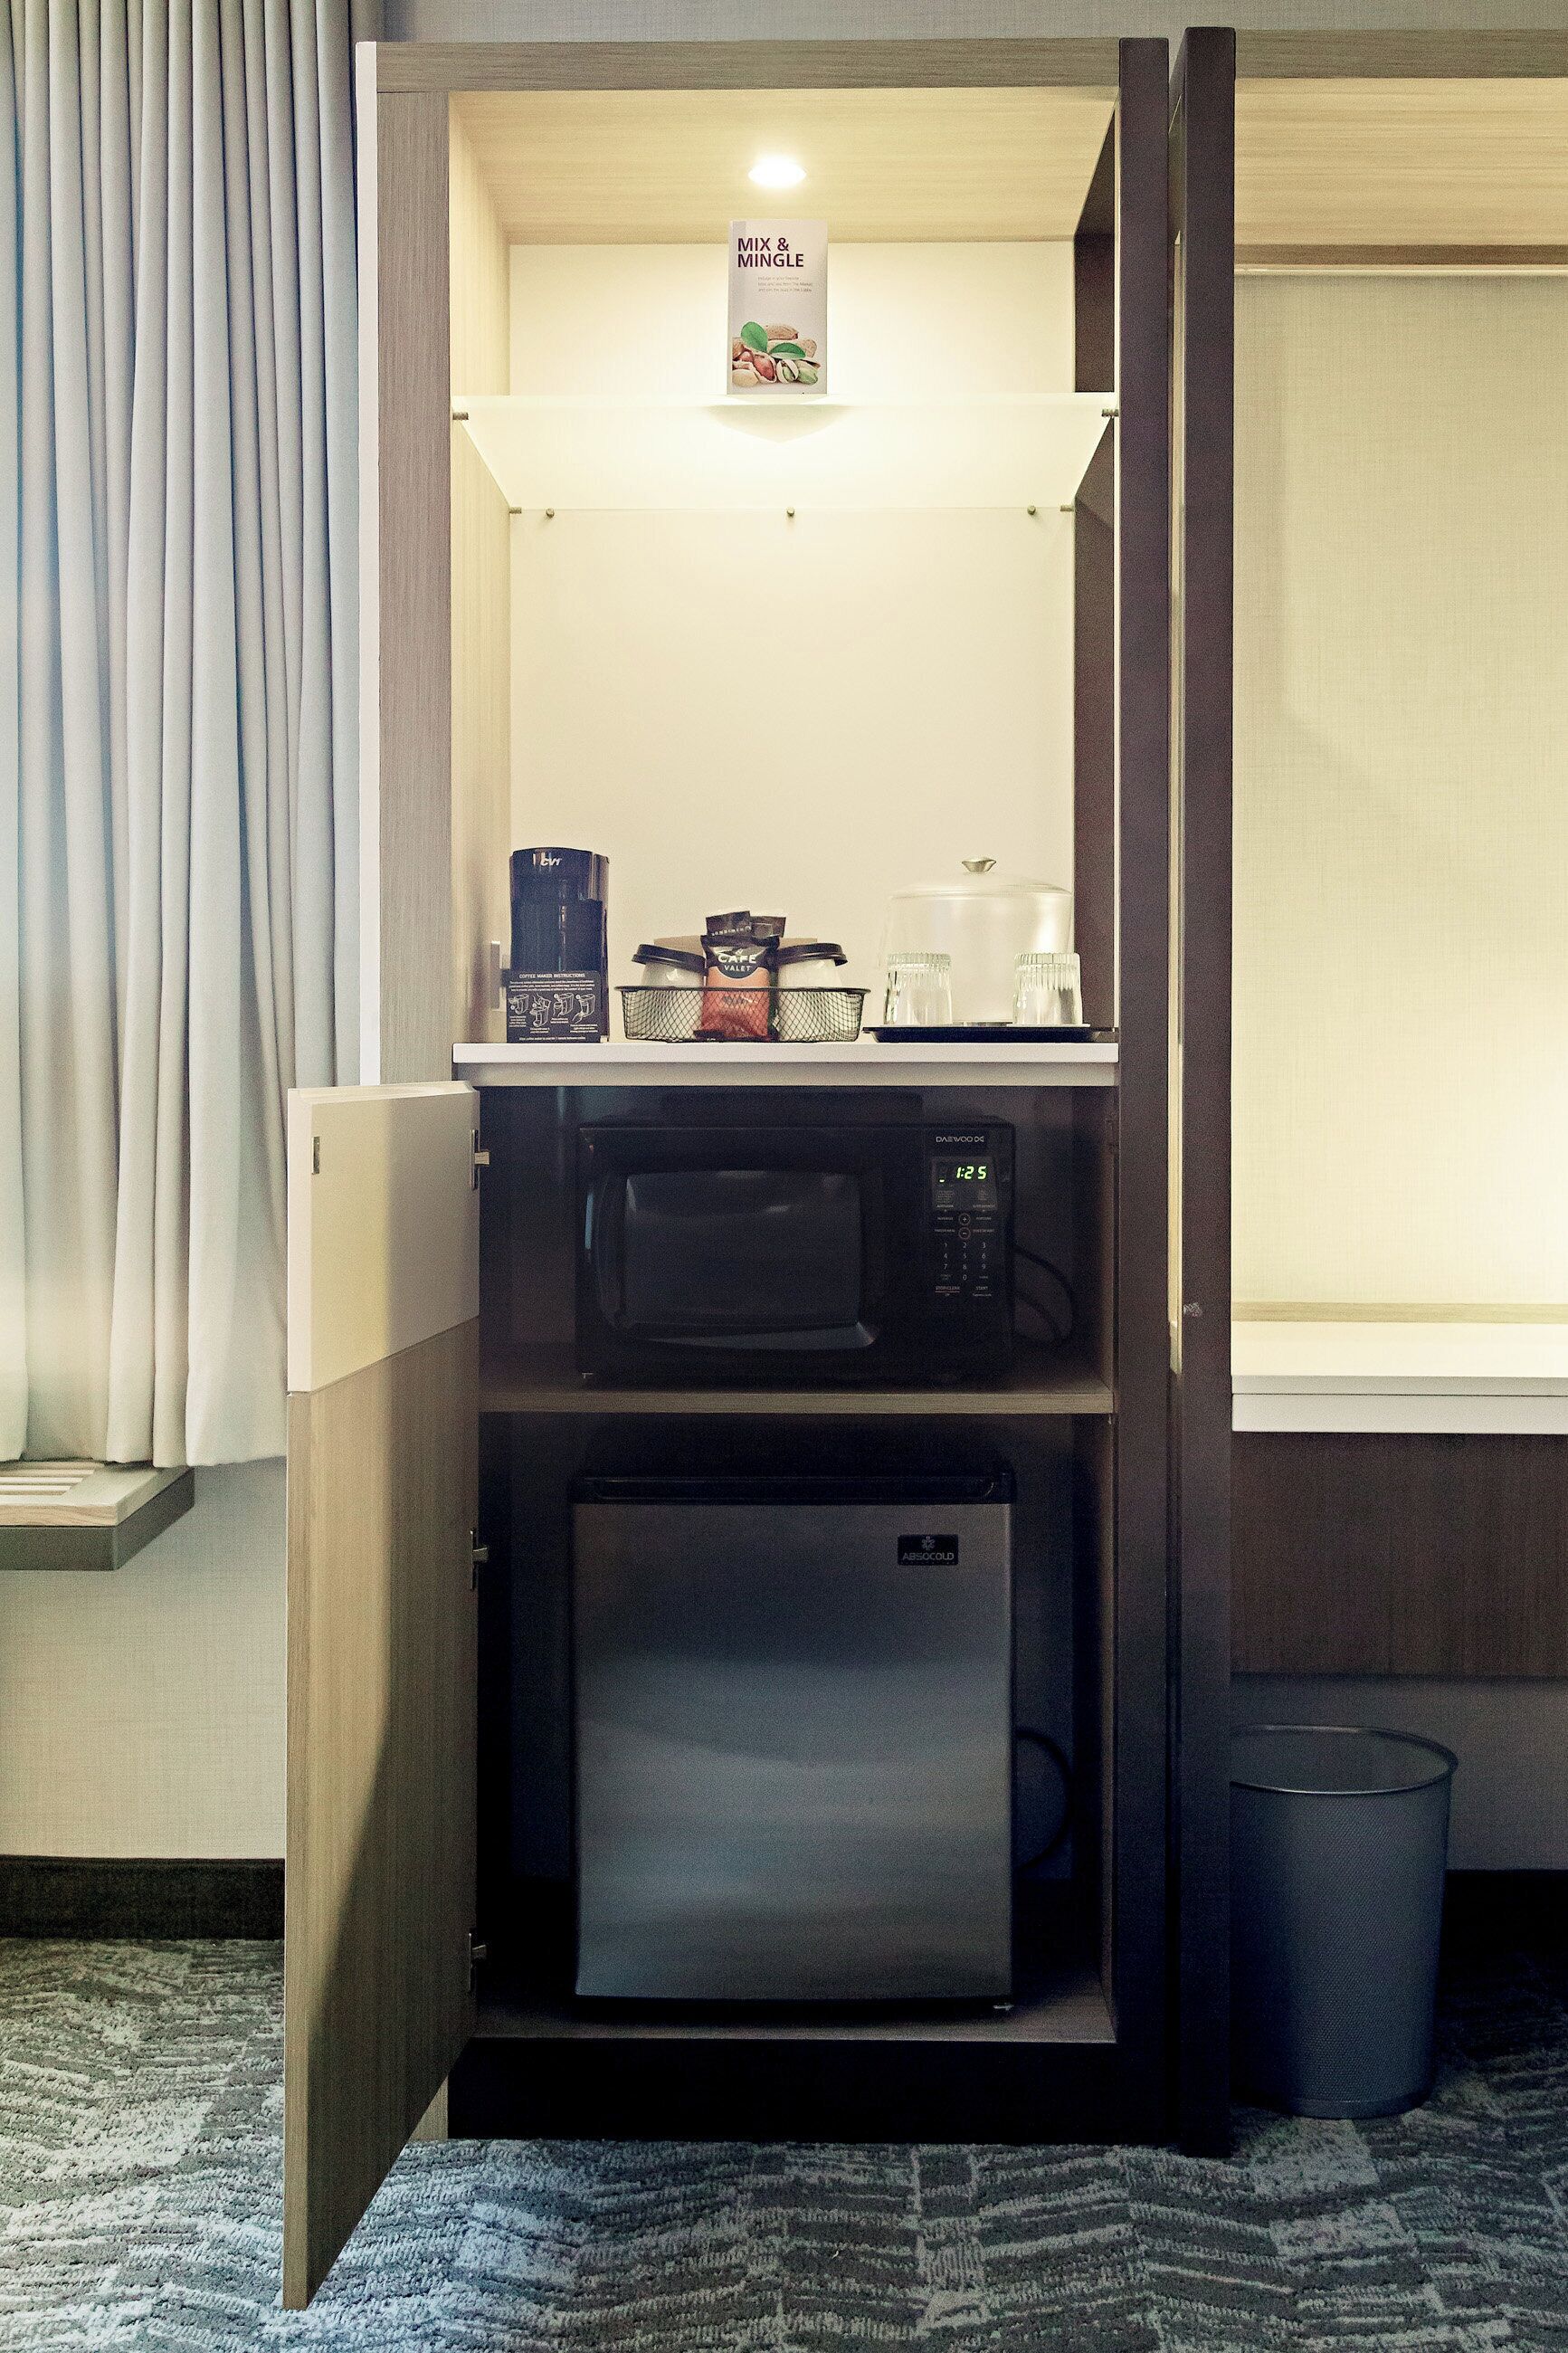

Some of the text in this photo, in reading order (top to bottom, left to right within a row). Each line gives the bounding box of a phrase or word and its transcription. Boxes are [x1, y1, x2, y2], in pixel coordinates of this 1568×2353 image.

[737, 237, 789, 252] MIX &
[737, 253, 804, 268] MINGLE
[956, 1166, 987, 1180] 1:25
[902, 1552, 955, 1561] ABSOCOLD
